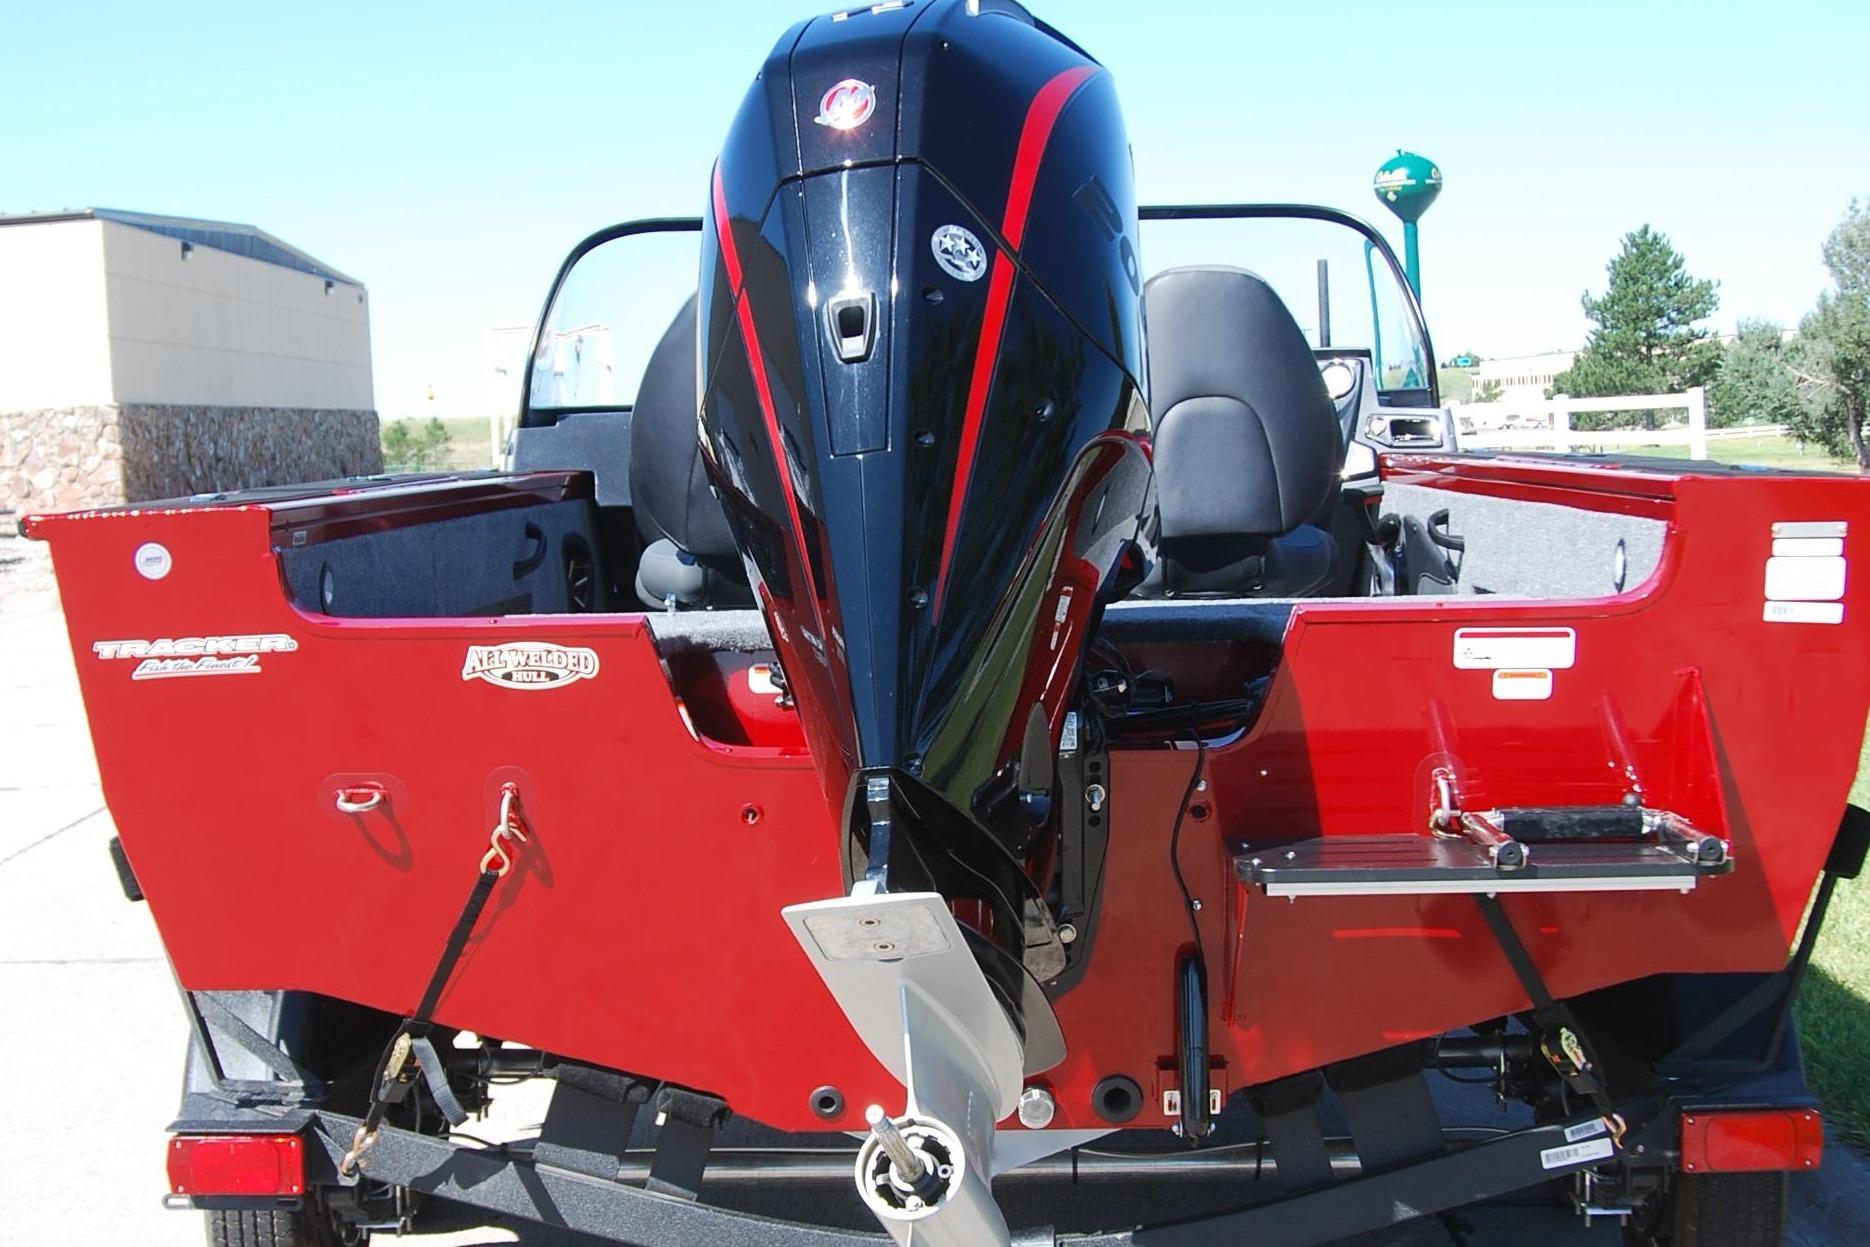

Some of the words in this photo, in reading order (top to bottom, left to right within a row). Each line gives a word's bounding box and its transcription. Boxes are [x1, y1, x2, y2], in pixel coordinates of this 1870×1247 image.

[96, 635, 287, 659] TRACKER
[139, 660, 167, 672] Fish
[172, 658, 193, 671] the
[466, 649, 507, 676] ALL
[507, 649, 595, 676] WELDED
[511, 671, 550, 682] HULL
